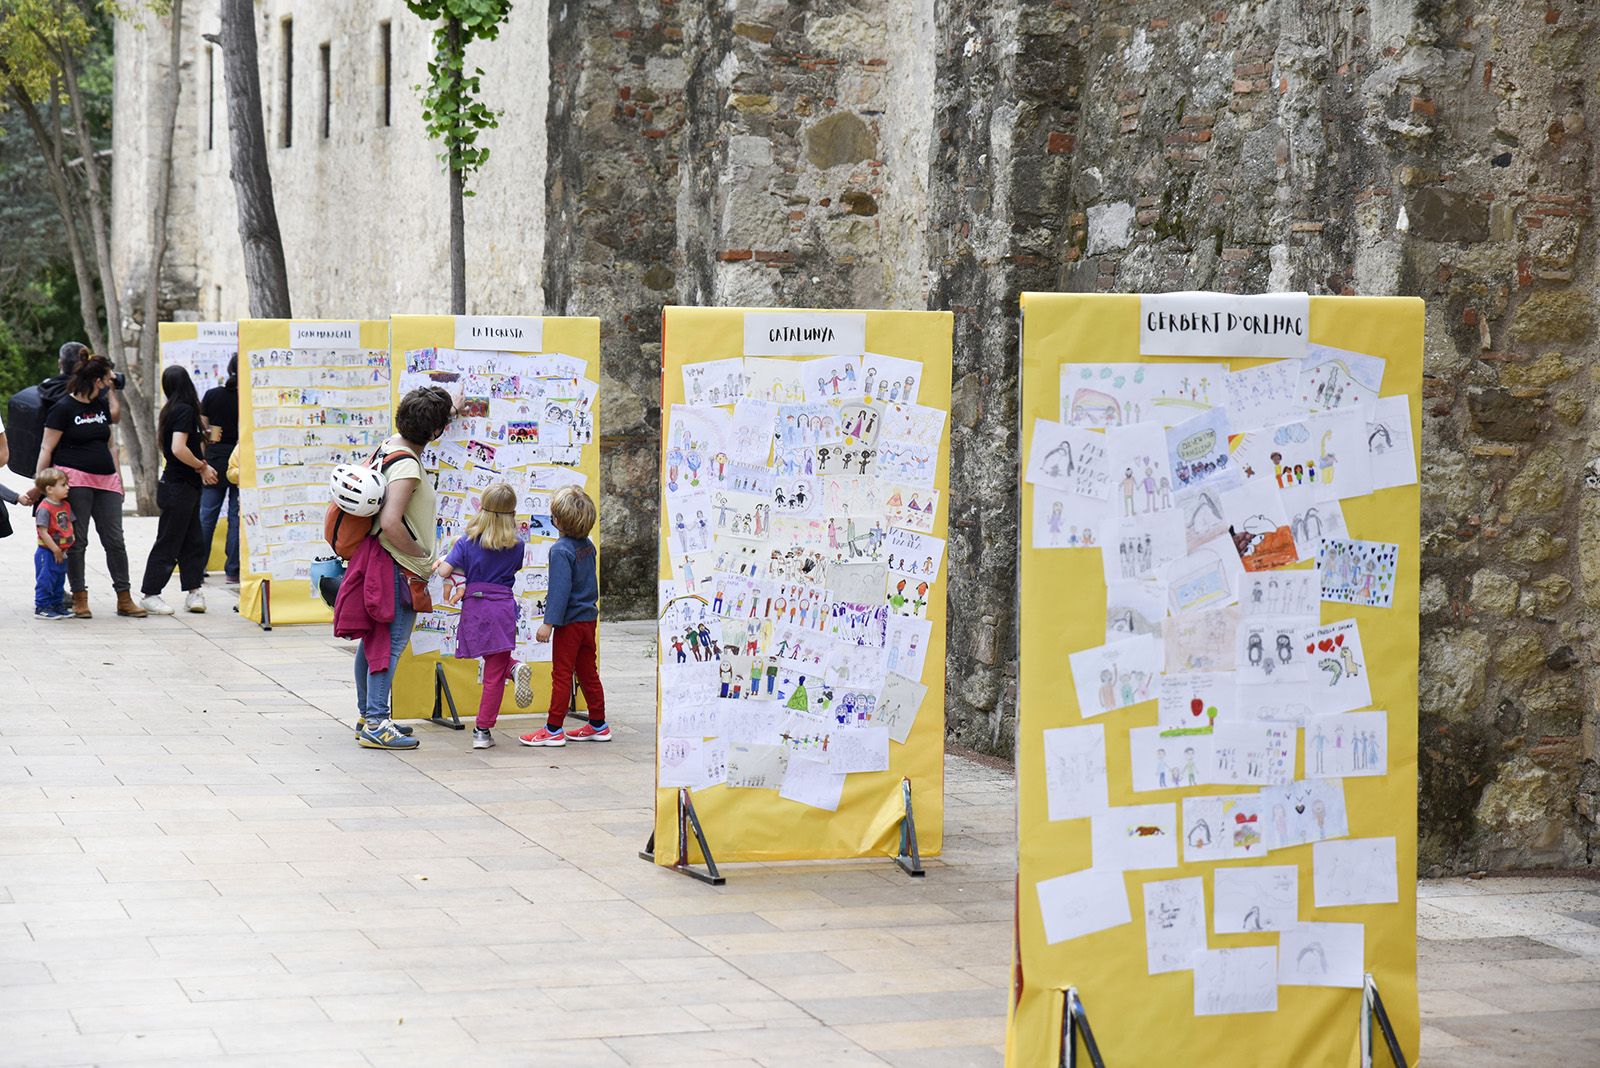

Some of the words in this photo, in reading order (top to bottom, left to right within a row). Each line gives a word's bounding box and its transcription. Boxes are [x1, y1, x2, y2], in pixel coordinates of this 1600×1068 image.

[1147, 311, 1221, 333] GERBERT
[1227, 312, 1303, 336] D'ORLHAC
[298, 329, 315, 339] JOAN
[316, 329, 352, 339] MARAGALL
[472, 326, 483, 337] LA
[485, 326, 524, 339] FLORESTA
[769, 326, 836, 343] CATALUNYA
